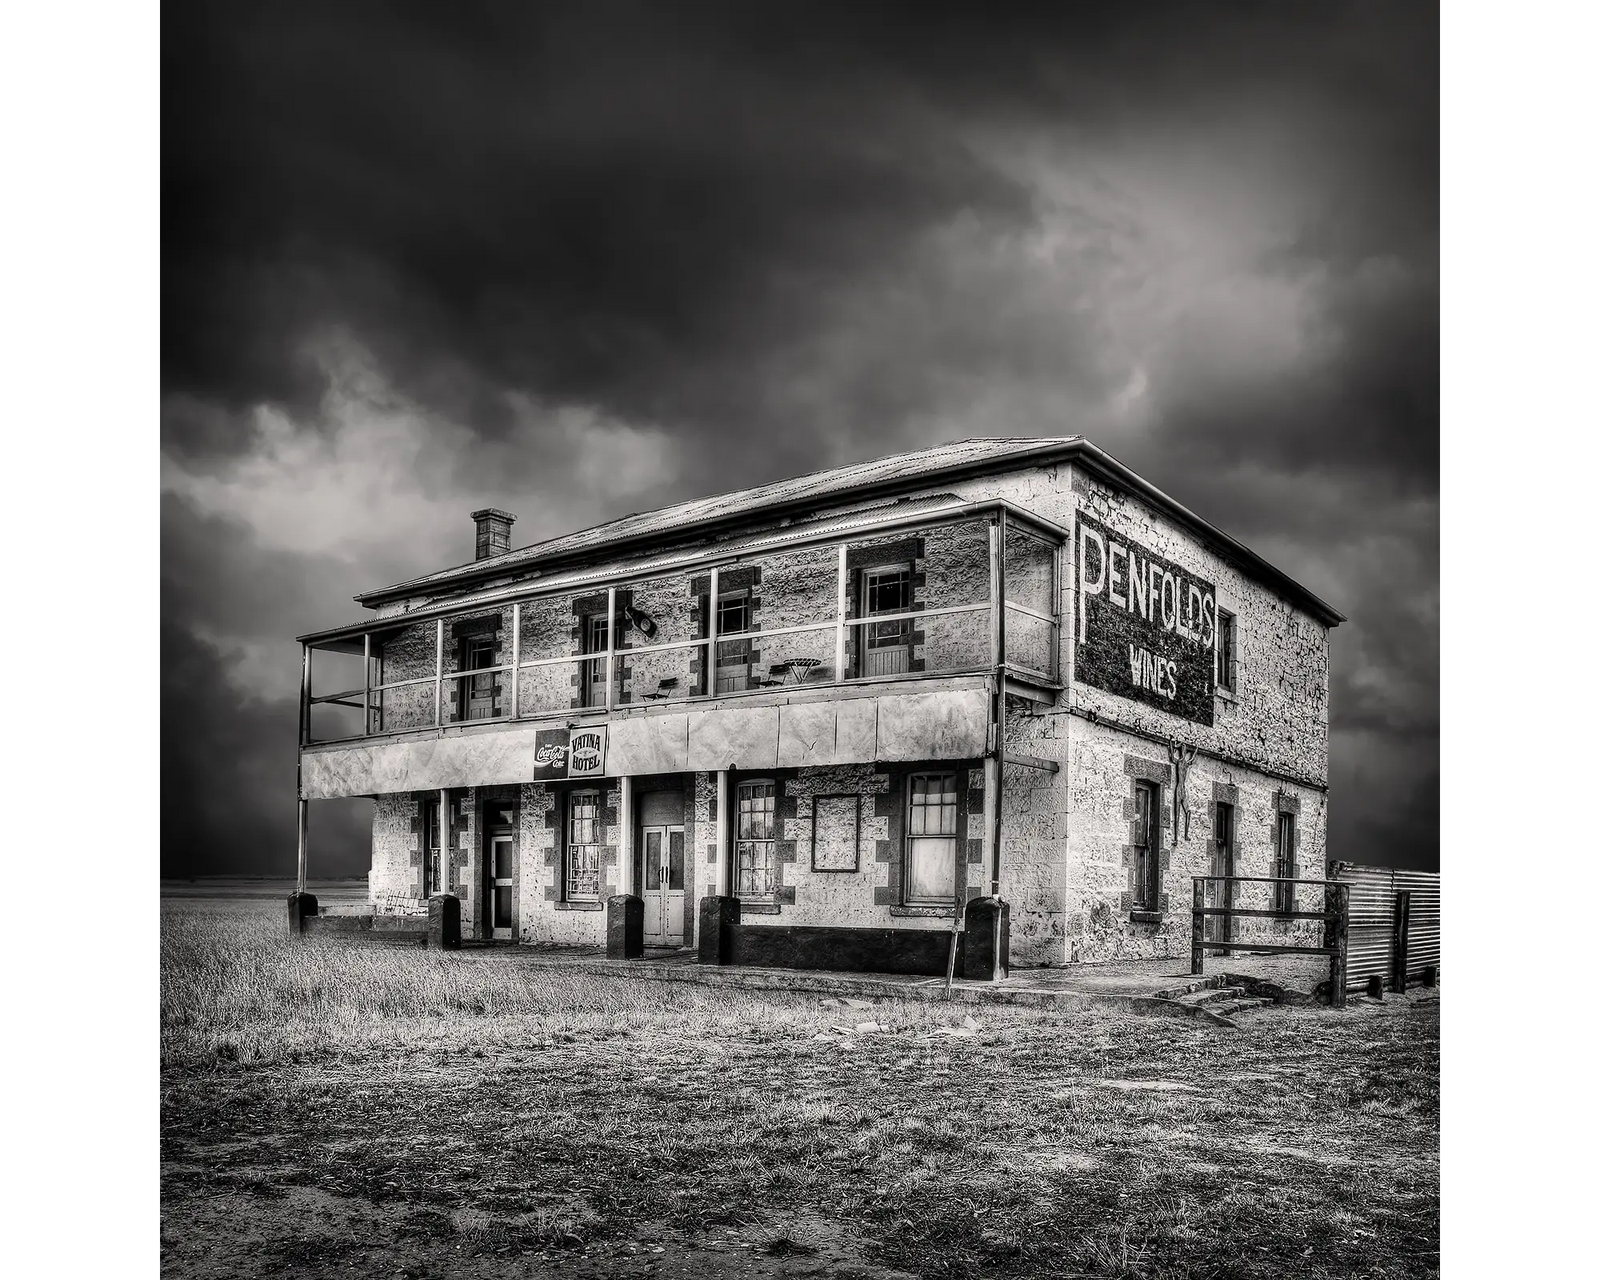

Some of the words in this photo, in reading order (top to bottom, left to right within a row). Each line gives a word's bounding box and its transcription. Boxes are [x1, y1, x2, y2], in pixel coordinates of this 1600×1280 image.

[1080, 523, 1214, 648] PENFOLDS
[1129, 643, 1177, 700] WINES
[572, 754, 600, 771] HOTEL
